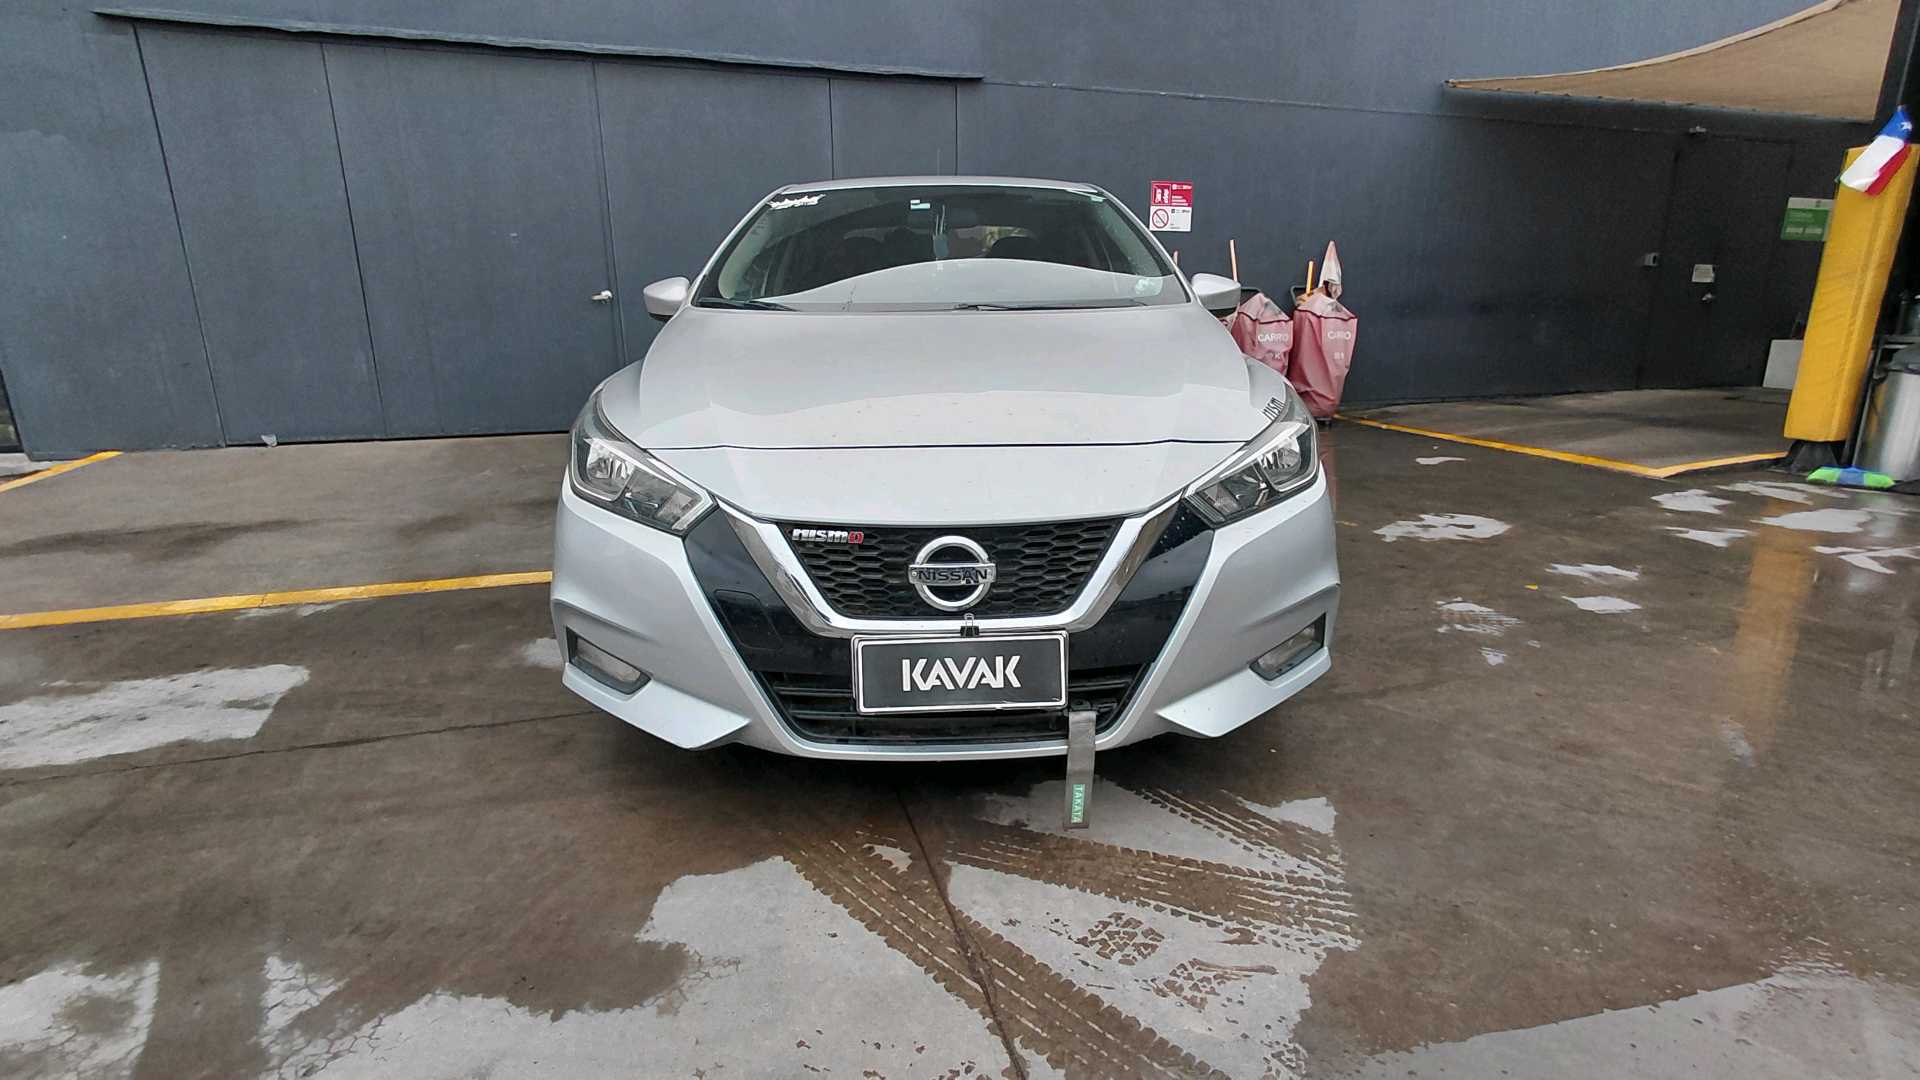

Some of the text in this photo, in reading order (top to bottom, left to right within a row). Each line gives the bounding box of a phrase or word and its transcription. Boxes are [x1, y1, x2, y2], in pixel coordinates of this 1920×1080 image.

[792, 528, 865, 544] NISMO
[917, 568, 989, 583] NISSAN
[902, 655, 1022, 692] KAVAK
[1071, 784, 1084, 823] TAKATA
